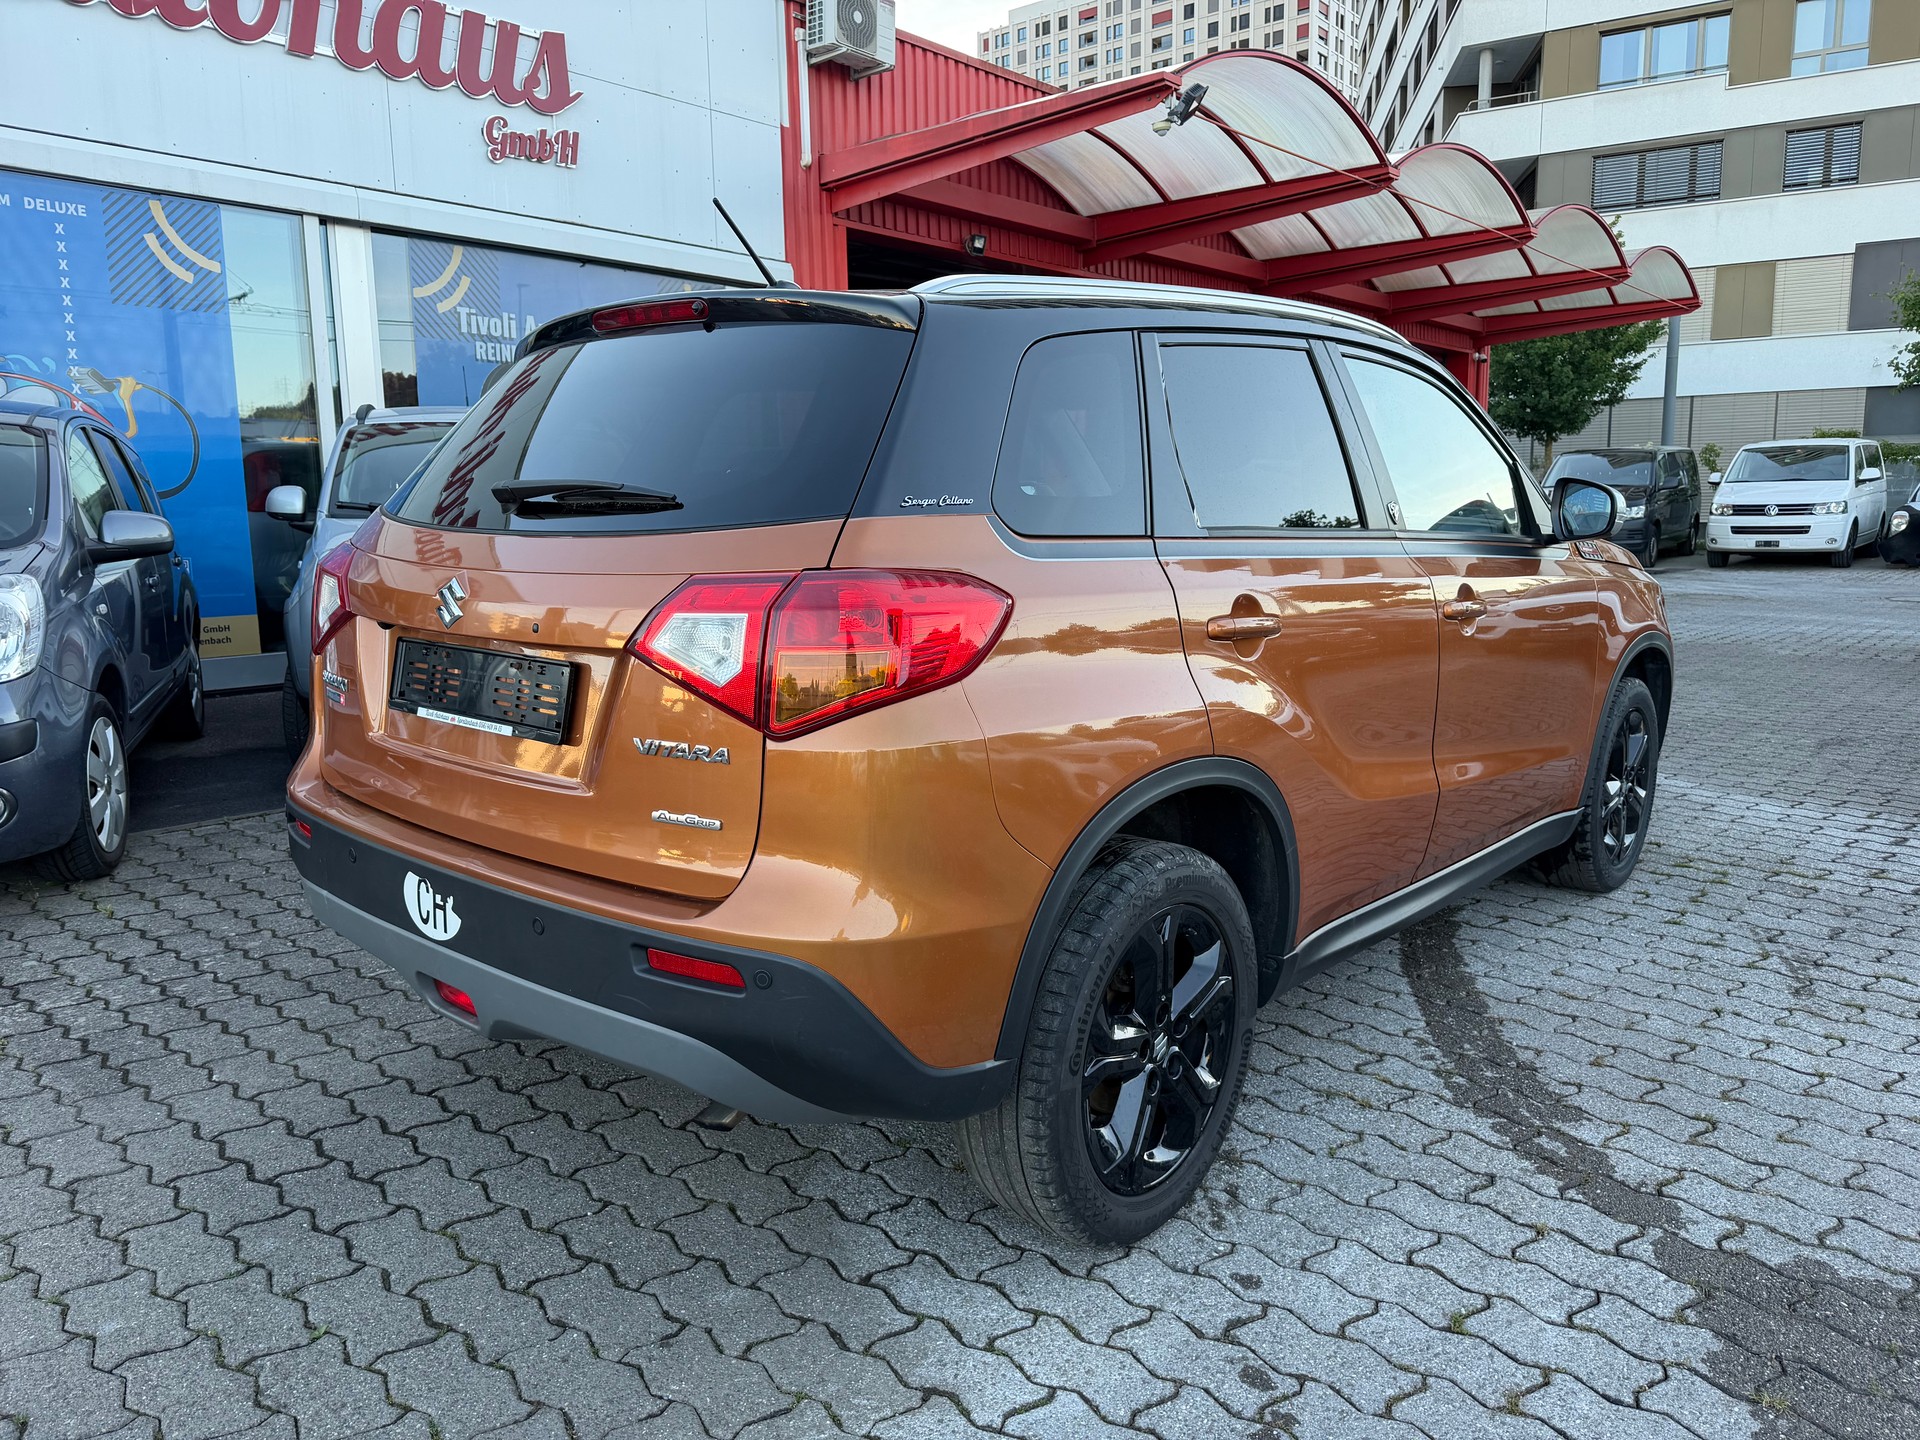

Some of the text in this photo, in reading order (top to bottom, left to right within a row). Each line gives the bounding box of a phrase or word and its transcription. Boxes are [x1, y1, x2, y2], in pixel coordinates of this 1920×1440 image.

[483, 115, 580, 168] GmbH
[23, 196, 88, 217] DELUXE
[456, 306, 518, 339] Tivoli
[901, 494, 974, 508] Sergio Cellano
[200, 635, 232, 646] enbach
[202, 624, 231, 634] GmbH
[633, 737, 731, 765] VITARA
[416, 877, 448, 935] CH
